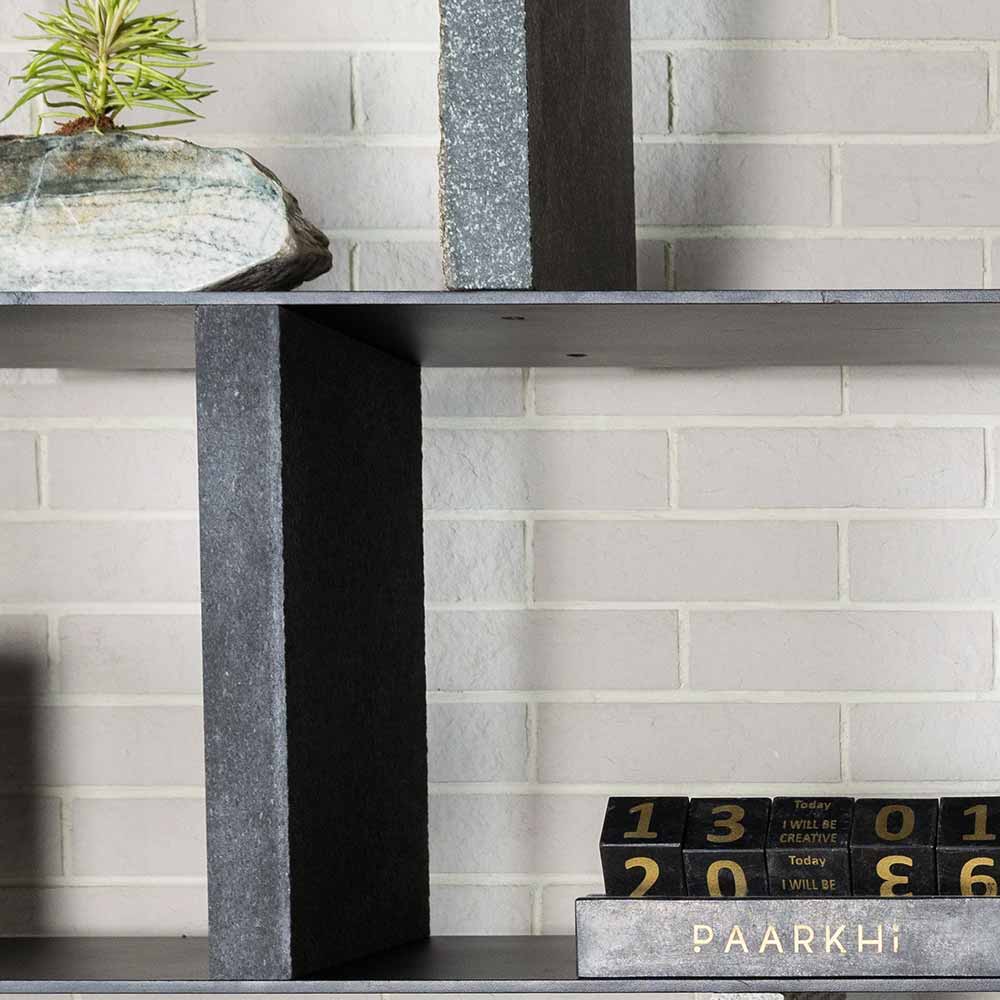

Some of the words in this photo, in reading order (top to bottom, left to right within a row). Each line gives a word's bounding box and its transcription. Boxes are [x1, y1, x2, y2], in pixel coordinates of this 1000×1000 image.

[793, 800, 832, 811] Today
[623, 802, 658, 839] 1
[706, 804, 745, 843] 3
[790, 819, 819, 830] WILL
[822, 819, 838, 830] BE
[961, 804, 997, 841] 1
[779, 832, 838, 843] CREATIVE
[788, 855, 826, 868] Today
[789, 879, 819, 890] WILL
[821, 879, 837, 890] BE
